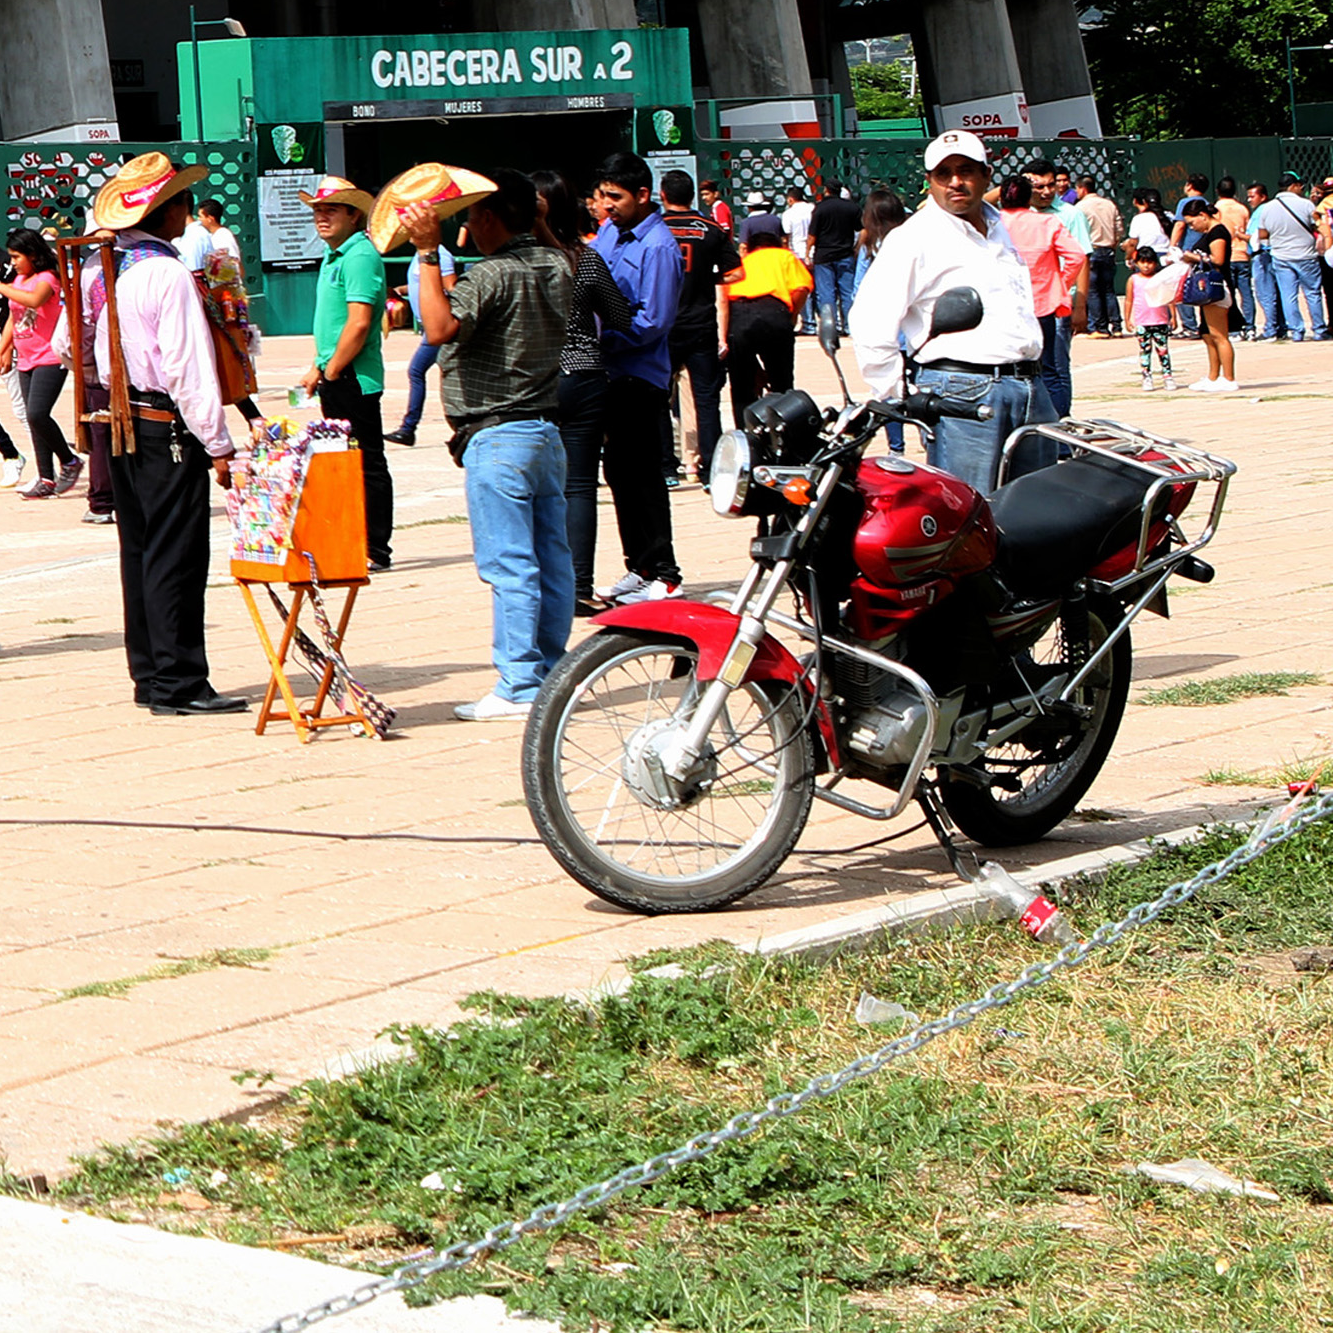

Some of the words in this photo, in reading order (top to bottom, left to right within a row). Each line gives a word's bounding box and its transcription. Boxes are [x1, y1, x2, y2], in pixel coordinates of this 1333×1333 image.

[371, 49, 522, 88] CABECERA
[531, 46, 582, 83] SUR
[594, 63, 607, 79] A
[610, 42, 633, 80] 2
[352, 105, 375, 117] BONO
[444, 101, 482, 114] MUJERES
[567, 97, 605, 108] HOMBRES
[962, 114, 1002, 126] SOPA
[88, 130, 110, 139] SOPA
